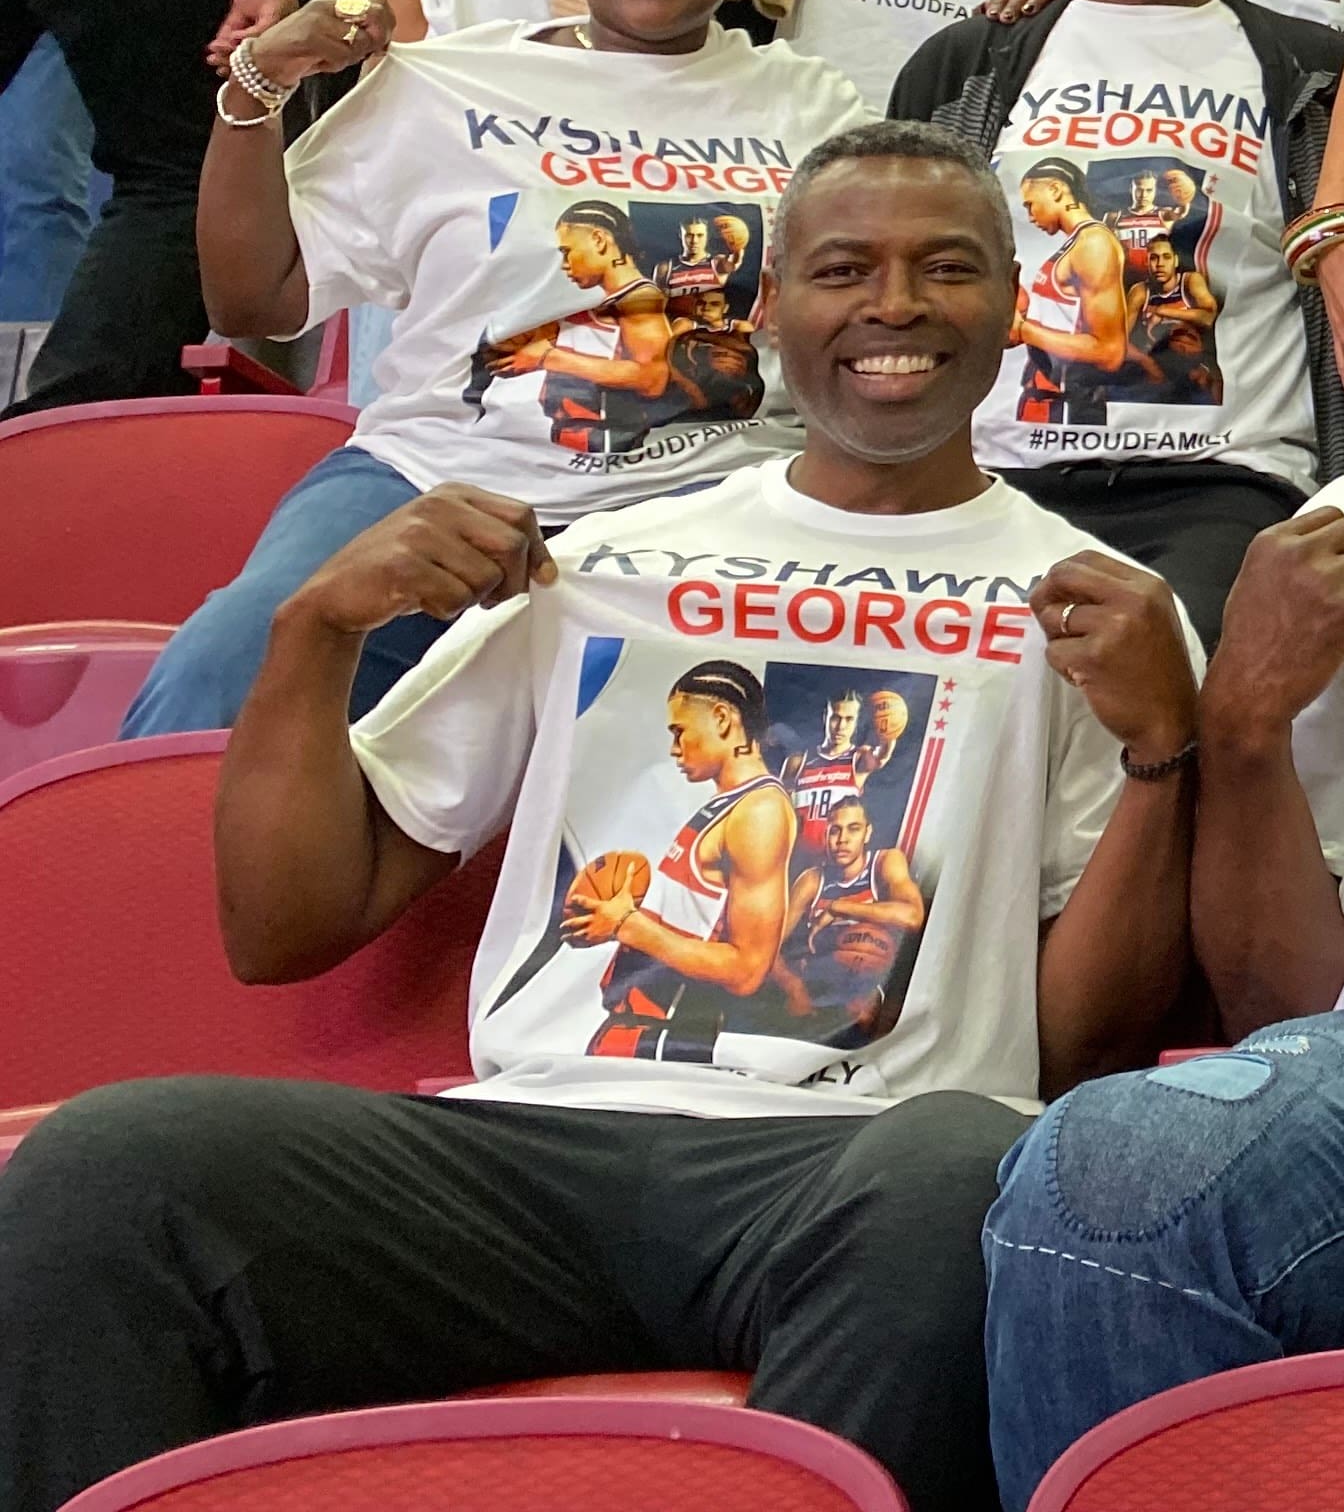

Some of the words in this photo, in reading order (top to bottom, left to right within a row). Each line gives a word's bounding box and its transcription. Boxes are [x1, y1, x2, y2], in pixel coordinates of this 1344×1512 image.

[1022, 79, 1267, 141] YSHAWN
[1022, 110, 1263, 177] GEORGE
[1130, 229, 1148, 249] 18
[578, 543, 1043, 605] KYSHAWN
[667, 579, 1032, 665] GEORGE
[809, 789, 832, 820] 18
